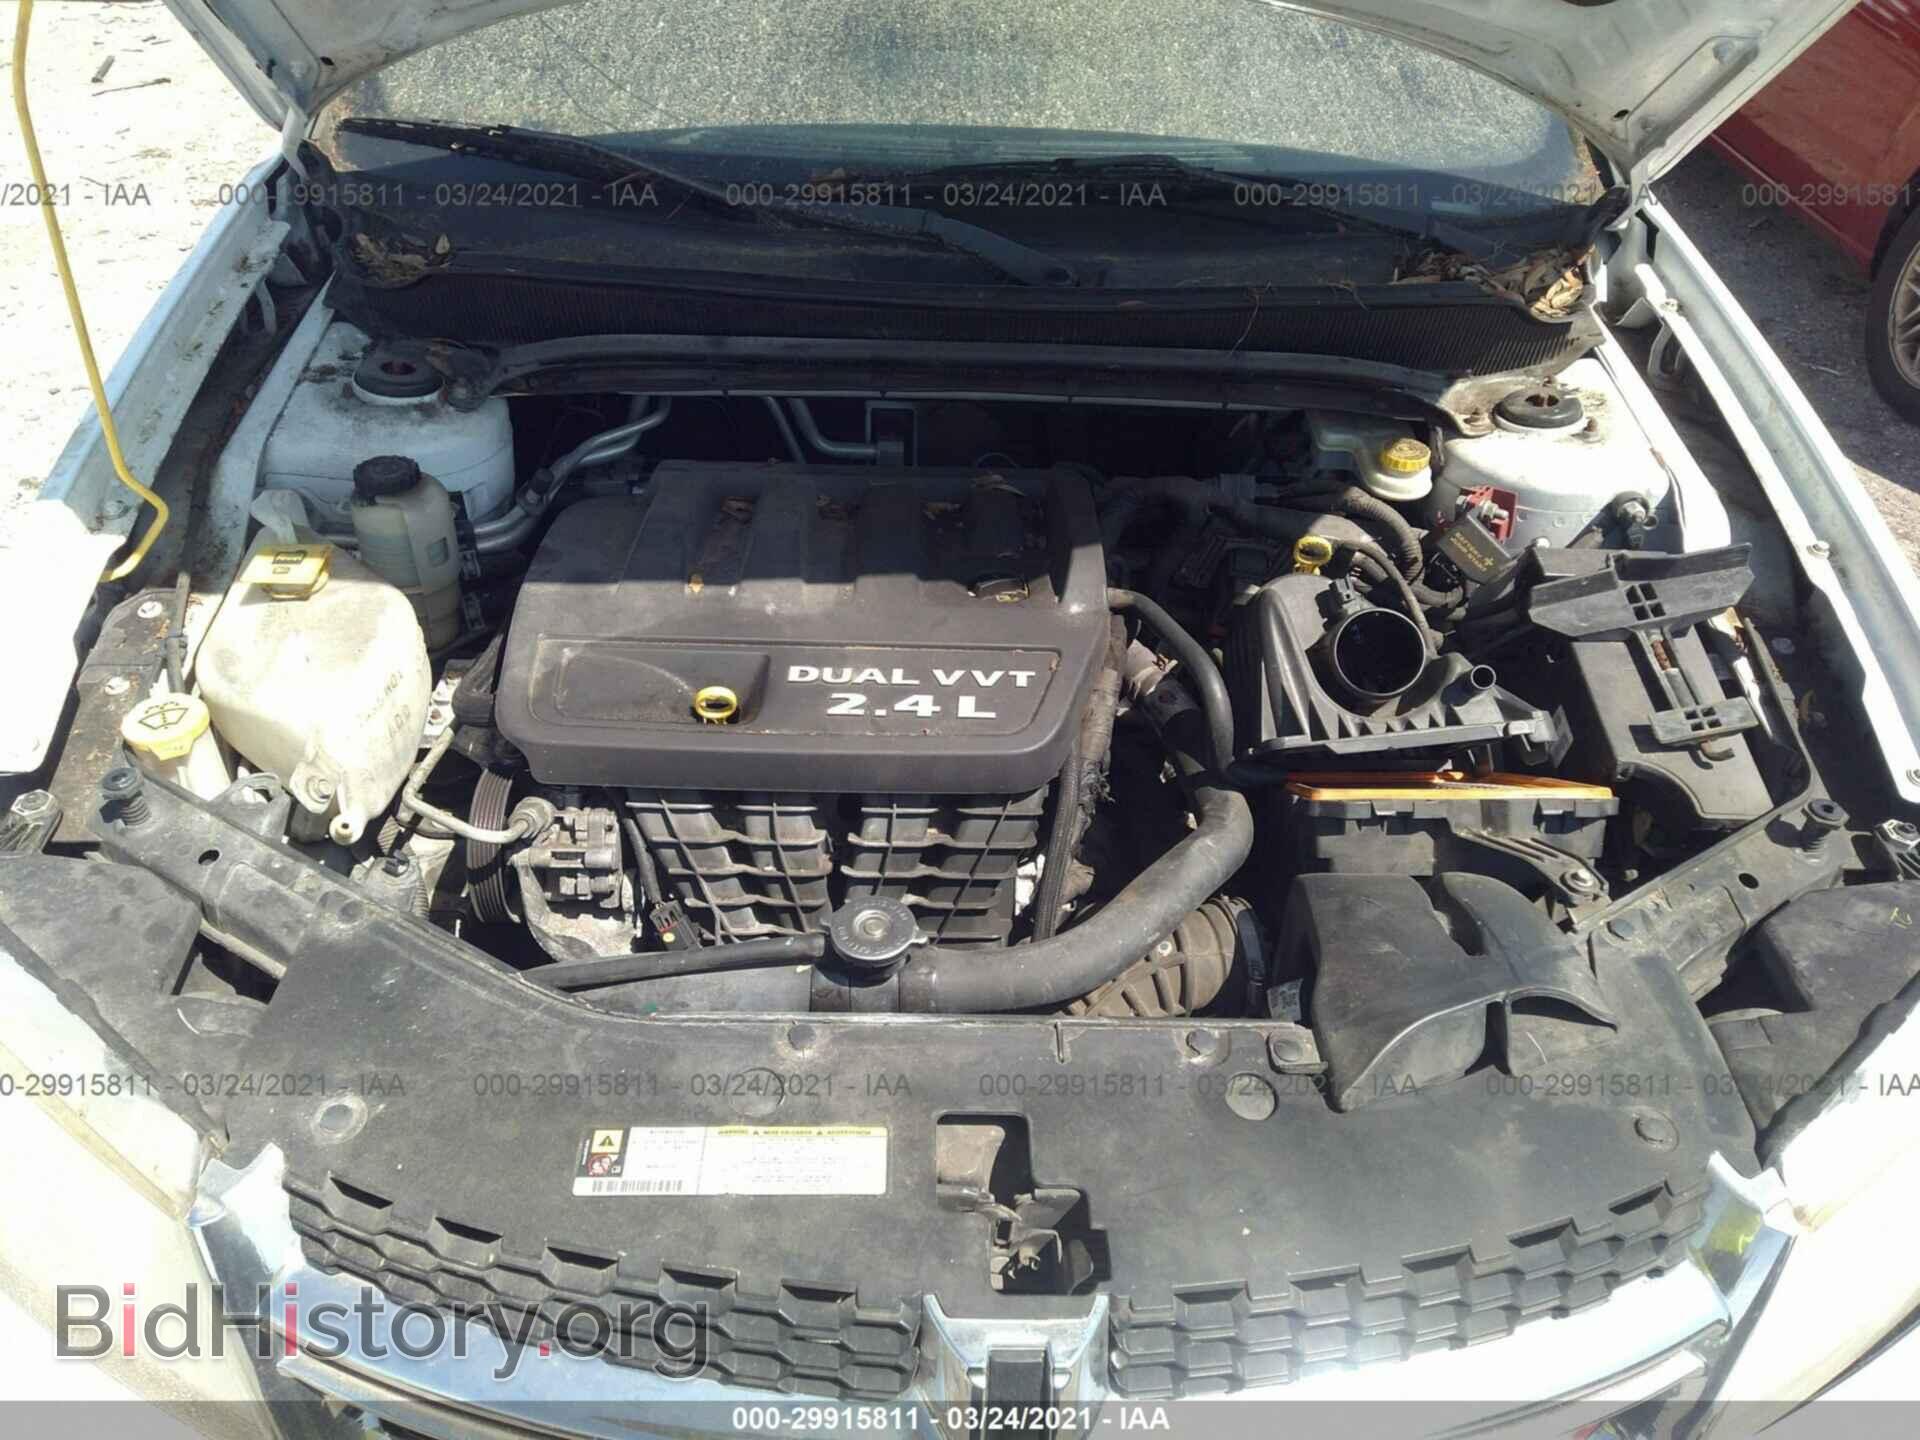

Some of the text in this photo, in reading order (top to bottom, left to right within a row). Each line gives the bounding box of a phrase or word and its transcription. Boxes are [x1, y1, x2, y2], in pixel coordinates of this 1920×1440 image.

[787, 665, 1036, 688] DUAL VVT
[826, 693, 997, 719] 2.4 L
